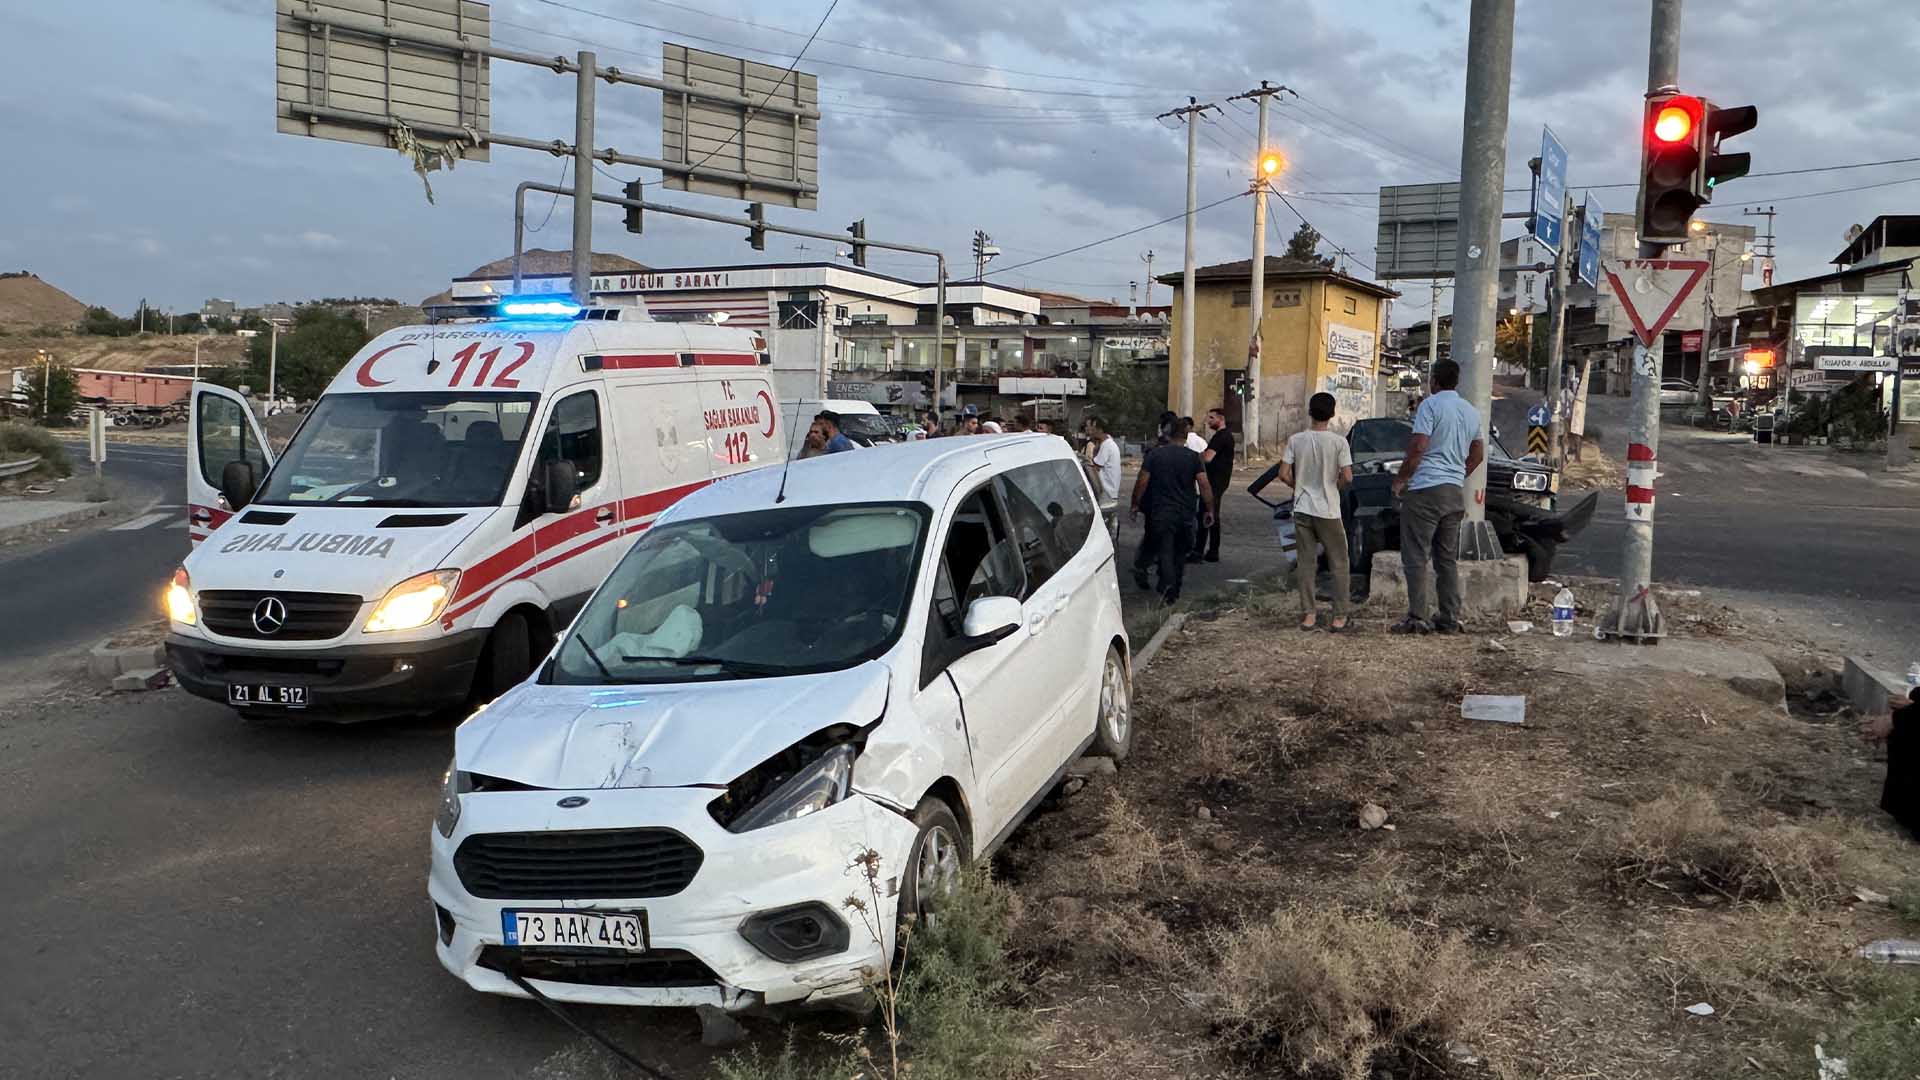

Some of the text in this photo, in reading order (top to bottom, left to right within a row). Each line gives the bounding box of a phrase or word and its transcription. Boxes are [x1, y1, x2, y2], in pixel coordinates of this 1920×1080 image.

[620, 273, 664, 289] DÜĞÜN
[675, 273, 729, 288] SARAYI
[448, 341, 535, 389] 112
[704, 405, 760, 430] SAĞLIK BAKANLIĞI
[725, 431, 751, 465] 112
[235, 685, 304, 703] 21 AL 512
[517, 916, 638, 946] 73 AAK 443
